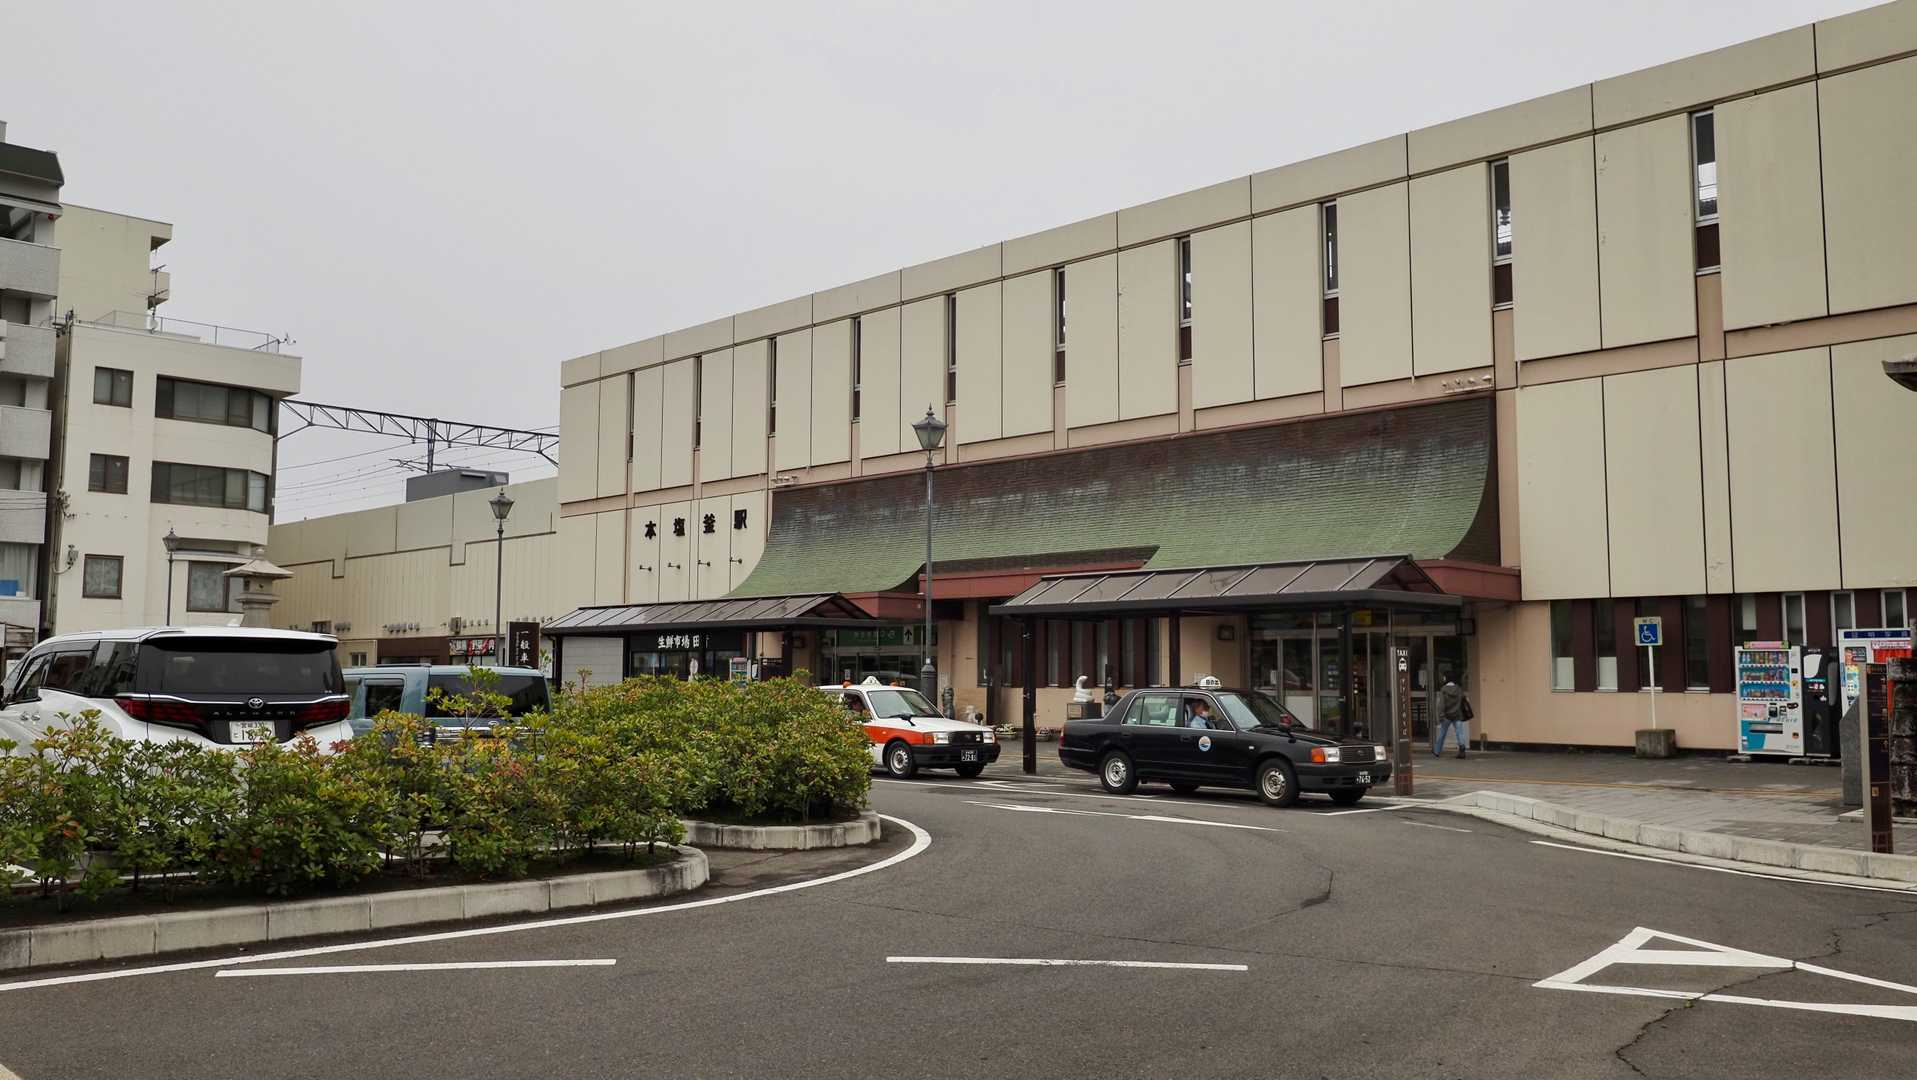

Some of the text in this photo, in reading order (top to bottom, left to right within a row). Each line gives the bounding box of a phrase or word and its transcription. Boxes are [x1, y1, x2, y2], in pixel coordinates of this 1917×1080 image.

[645, 509, 747, 540] 本塩釜駅
[520, 630, 531, 664] 一般車
[657, 634, 690, 649] 生鮮市場
[1397, 649, 1408, 657] TAXI
